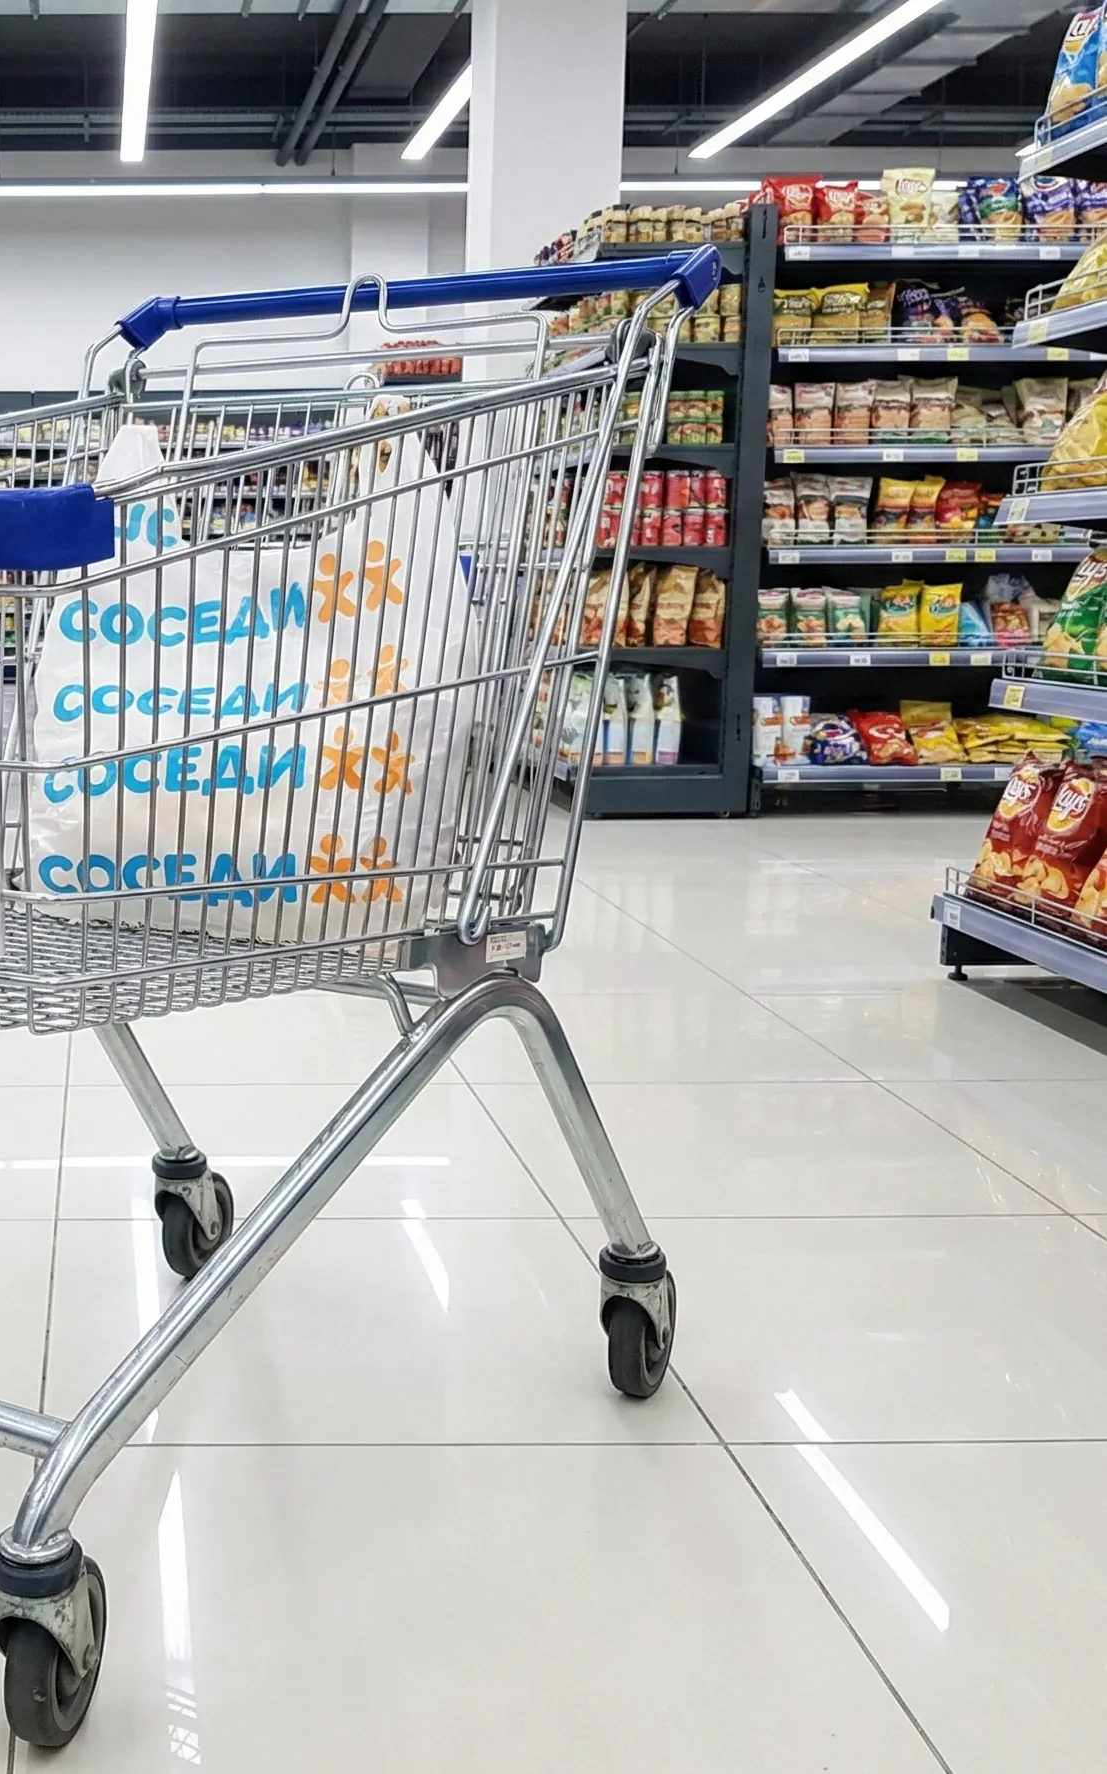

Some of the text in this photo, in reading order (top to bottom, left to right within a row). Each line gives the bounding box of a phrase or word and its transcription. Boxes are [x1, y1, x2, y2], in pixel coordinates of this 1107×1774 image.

[58, 581, 307, 648] СОСЕДИ
[52, 682, 310, 722] СОСЕДИ
[43, 744, 307, 804] СОСЕДИ
[38, 853, 299, 908] СОСЕДИ
